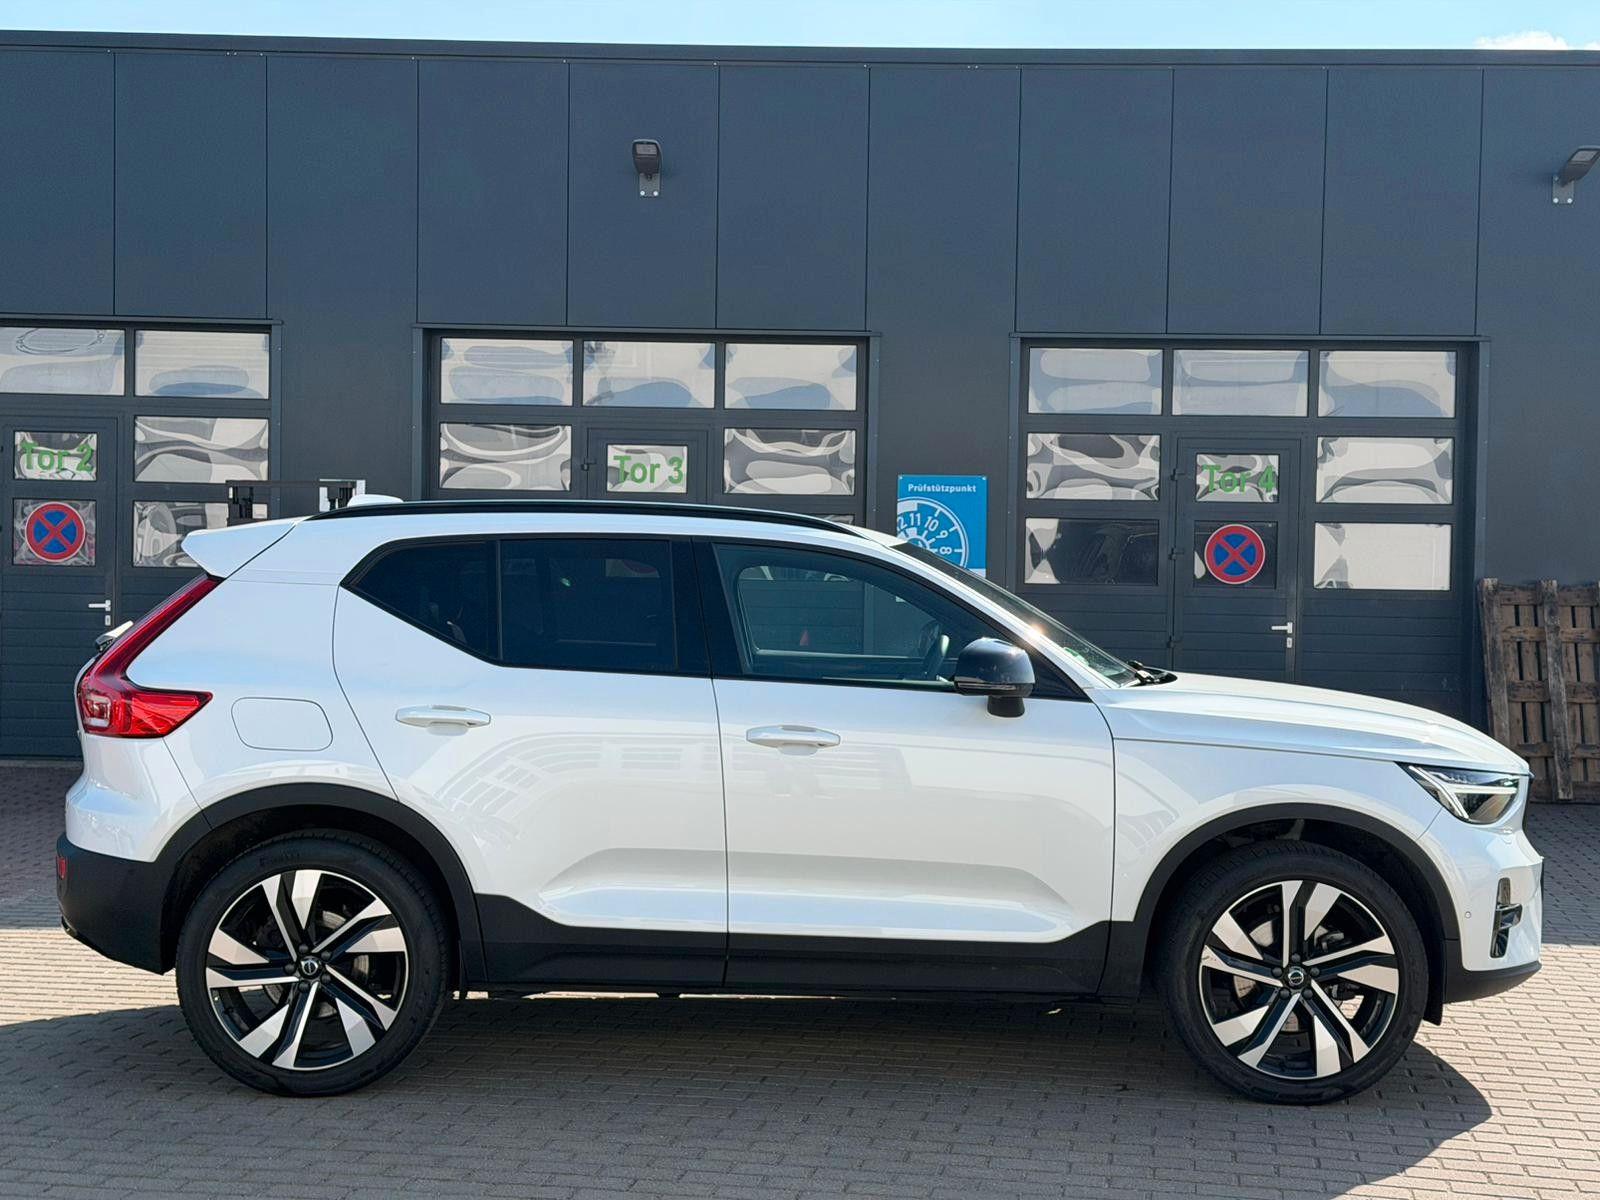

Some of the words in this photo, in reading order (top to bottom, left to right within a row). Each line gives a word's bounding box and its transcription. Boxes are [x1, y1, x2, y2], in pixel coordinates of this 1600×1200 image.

[20, 441, 70, 471] Tor
[76, 443, 94, 471] 2
[613, 455, 661, 484] Tor
[667, 456, 684, 484] 3
[1202, 464, 1251, 493] Tor
[1258, 464, 1275, 493] 4
[907, 483, 977, 494] Prüfstützpunkt
[897, 516, 908, 532] 2
[909, 513, 921, 526] 11
[924, 516, 939, 532] 10
[936, 530, 949, 539] 9
[940, 546, 953, 555] 8
